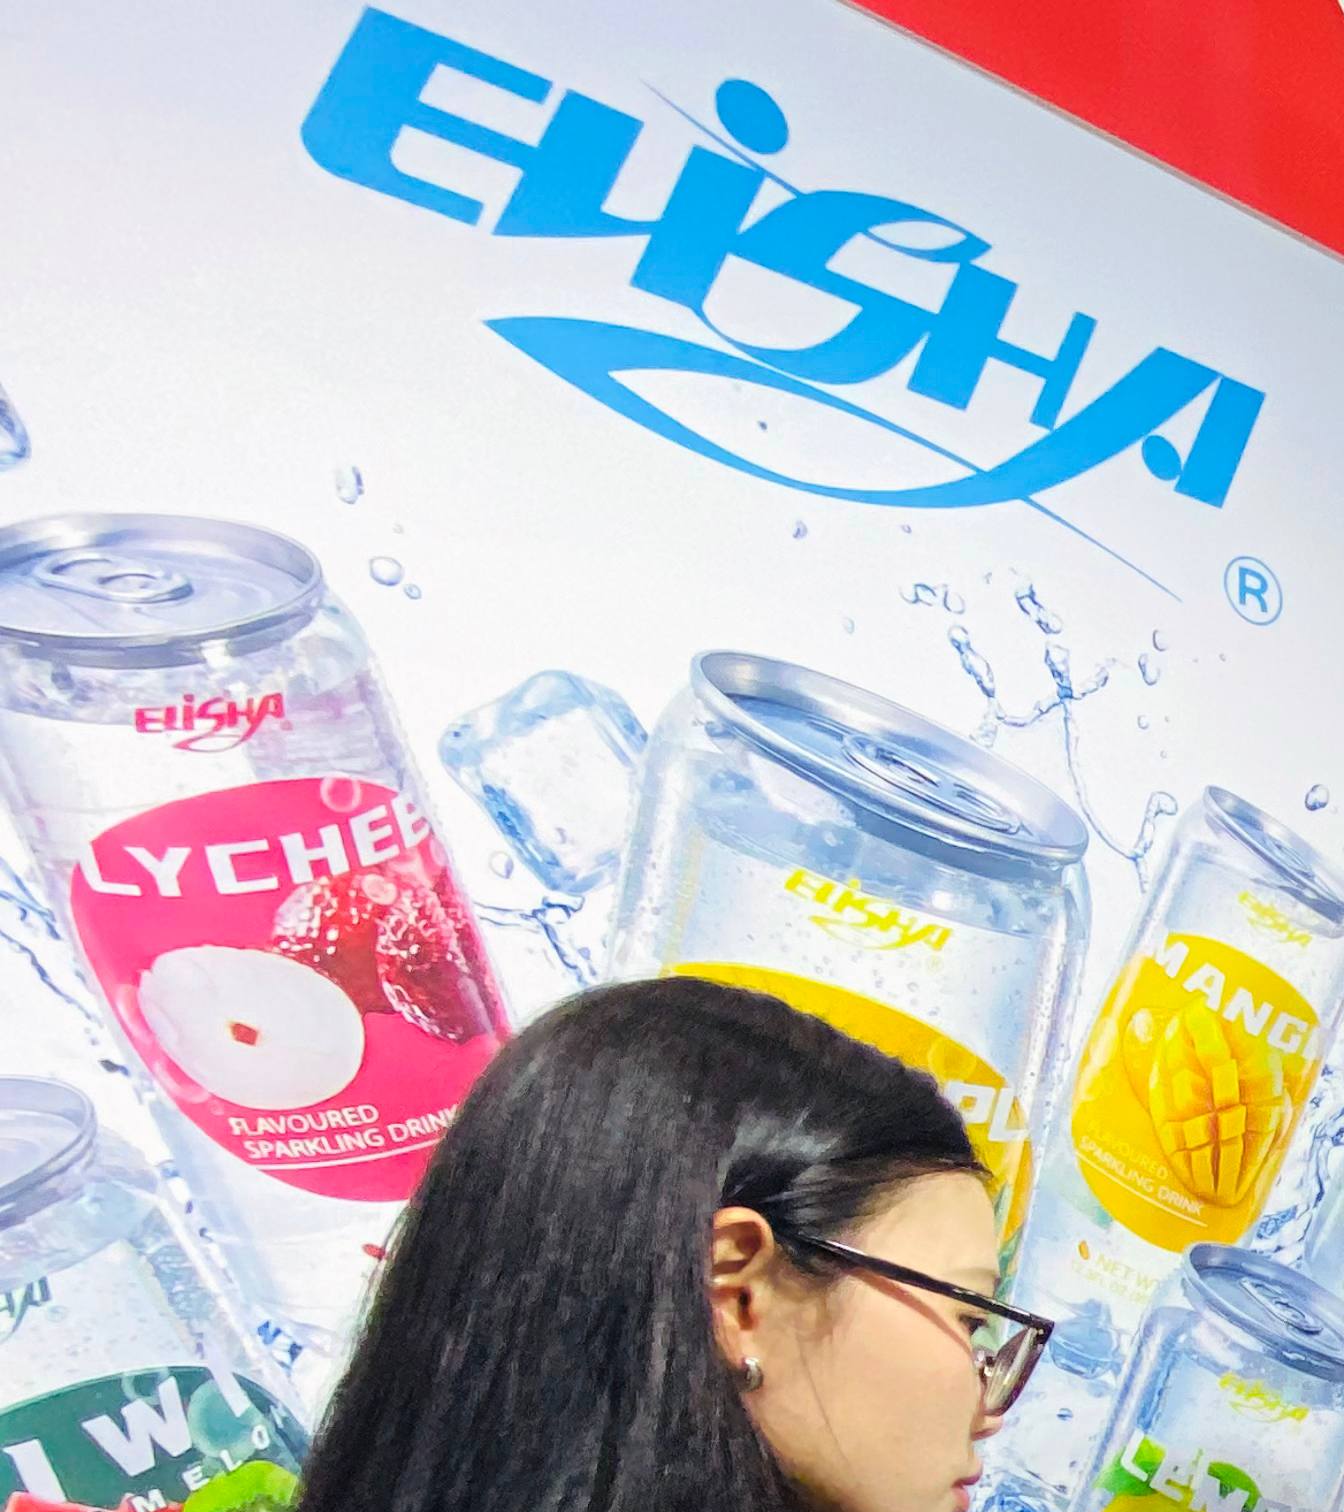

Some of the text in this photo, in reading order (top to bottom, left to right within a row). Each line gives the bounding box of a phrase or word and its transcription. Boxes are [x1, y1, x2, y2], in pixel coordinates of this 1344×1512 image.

[228, 1104, 379, 1136] FLAVOURED
[243, 1127, 385, 1160] SPARKLING
[1079, 1135, 1205, 1217] SPARKLING DRINK
